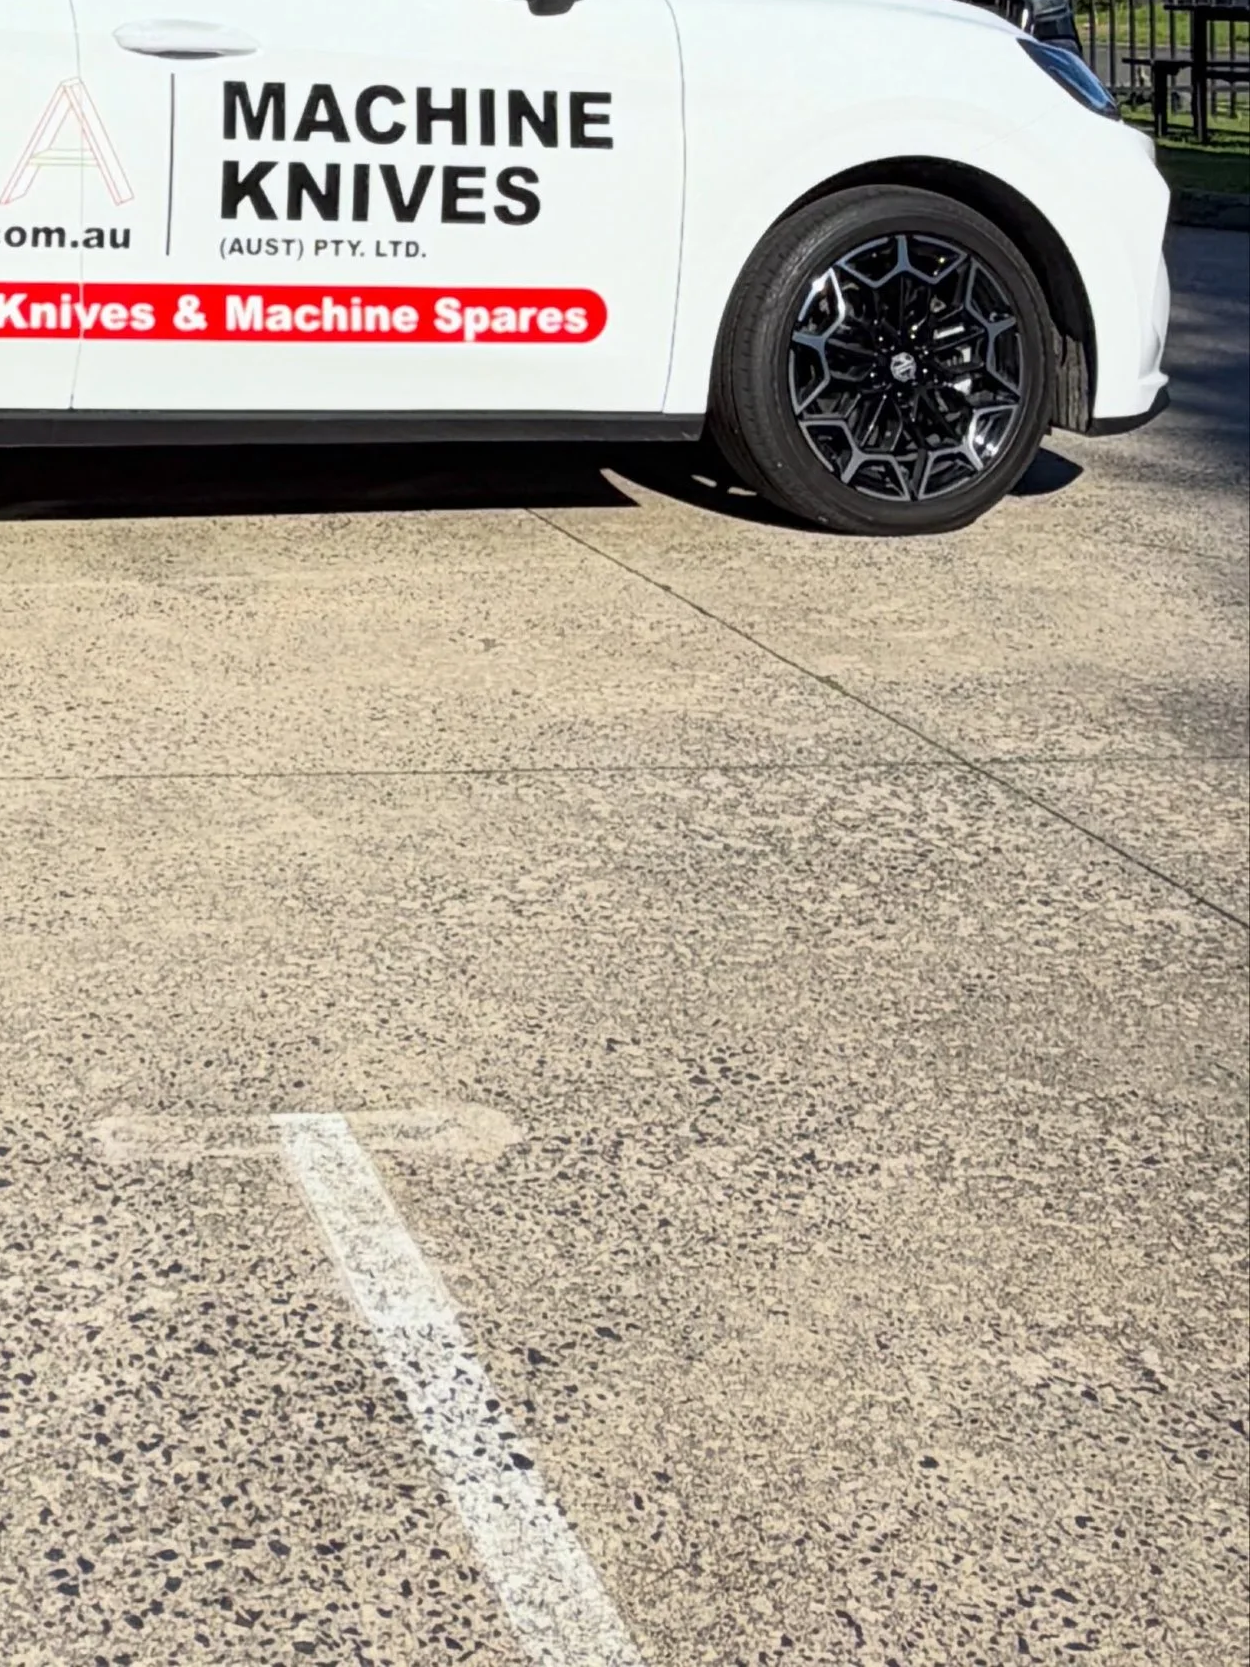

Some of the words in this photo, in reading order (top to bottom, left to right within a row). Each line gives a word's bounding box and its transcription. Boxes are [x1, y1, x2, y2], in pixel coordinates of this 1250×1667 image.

[223, 80, 614, 150] MACHINE
[220, 160, 541, 226] KNIVES
[220, 237, 304, 259] (AUST)
[314, 239, 365, 257] PTY.
[375, 240, 427, 258] LTD.
[173, 294, 208, 331] &
[226, 295, 419, 333] Machine
[434, 297, 589, 341] Spares
